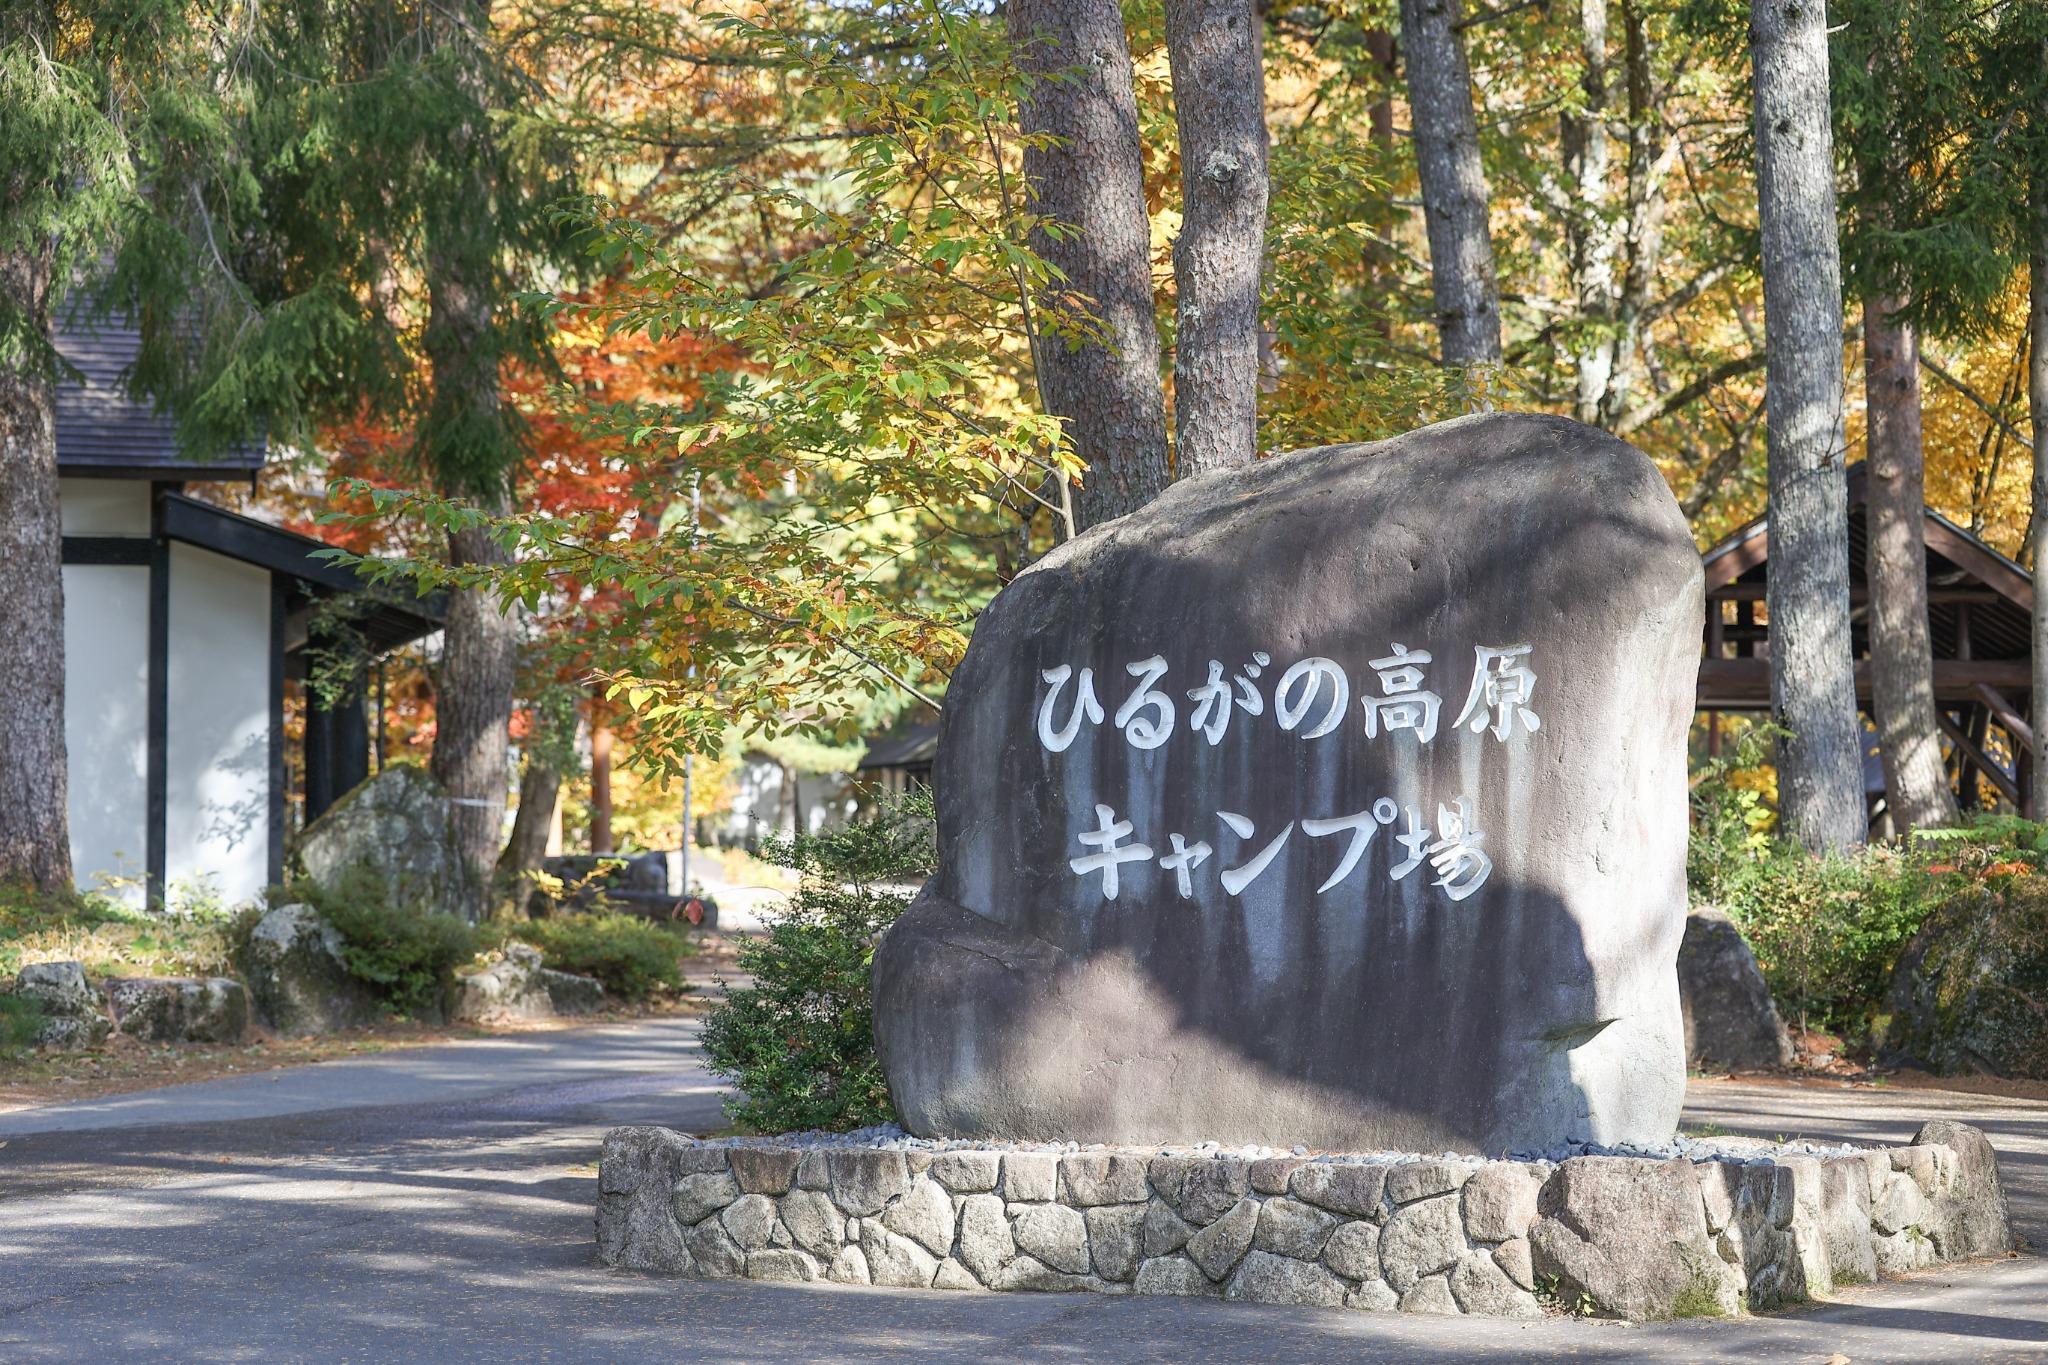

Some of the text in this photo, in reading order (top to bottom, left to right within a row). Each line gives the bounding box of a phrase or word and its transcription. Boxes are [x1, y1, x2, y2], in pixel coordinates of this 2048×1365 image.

[1037, 641, 1542, 752] ひるがの高原
[1069, 797, 1494, 901] キャンプ場
